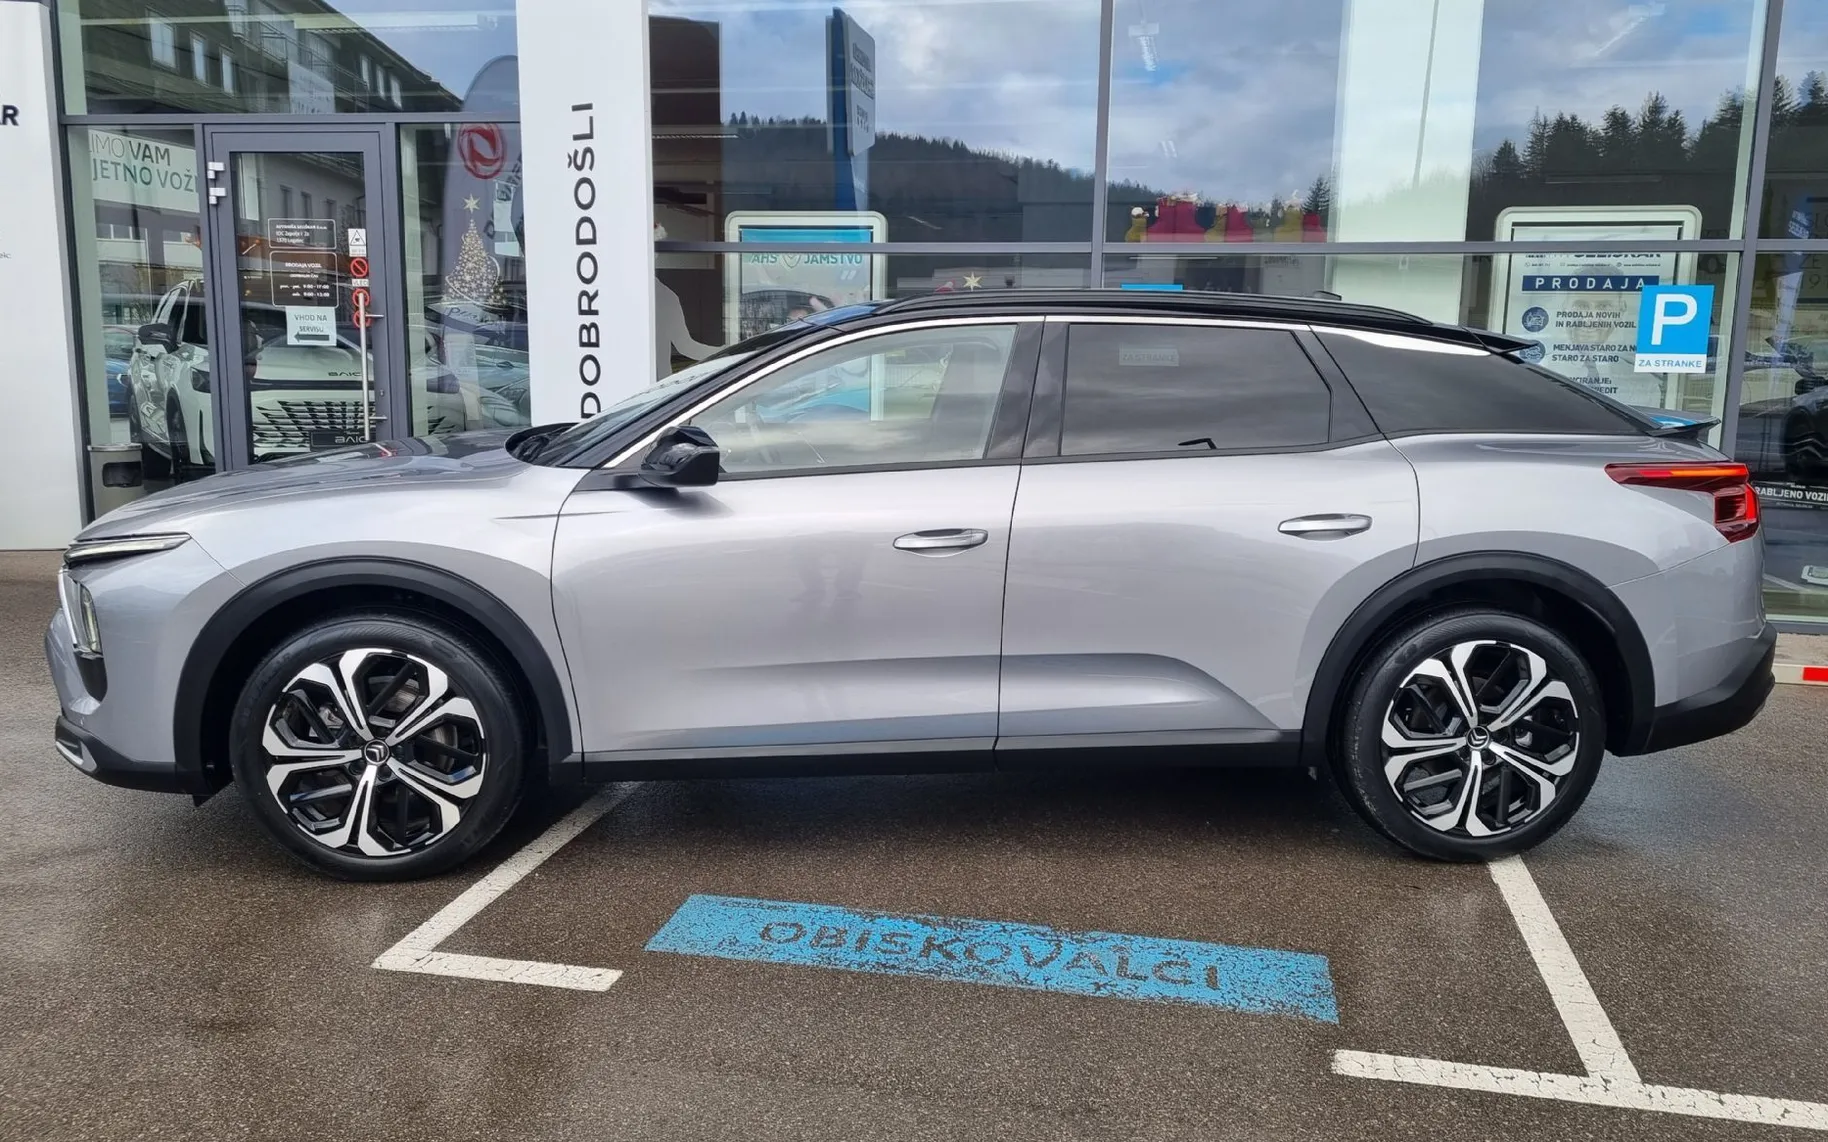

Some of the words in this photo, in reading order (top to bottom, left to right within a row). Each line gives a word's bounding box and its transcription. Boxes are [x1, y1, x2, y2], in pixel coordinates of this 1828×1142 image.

[0, 104, 20, 126] R
[89, 133, 125, 158] IMO
[128, 140, 171, 167] VAM
[567, 102, 602, 420] DOBRODOŠLI
[1535, 277, 1645, 289] PRODAJA
[1556, 311, 1594, 319] PRODAJA
[1595, 311, 1621, 319] NOVIH
[1651, 293, 1698, 346] P
[1555, 320, 1564, 328] IN
[1565, 320, 1612, 328] RABLJENIH
[1613, 321, 1637, 329] VOZIL
[1553, 343, 1589, 352] MENJAVA
[1590, 344, 1617, 352] STARO
[1617, 344, 1629, 352] ZA
[1629, 344, 1637, 352] N
[1551, 354, 1579, 362] STARO
[1592, 354, 1620, 363] STARO
[1654, 360, 1703, 368] STRANKE
[1755, 485, 1804, 500] RABLJENO
[758, 921, 1219, 991] OBISKOVALCI
